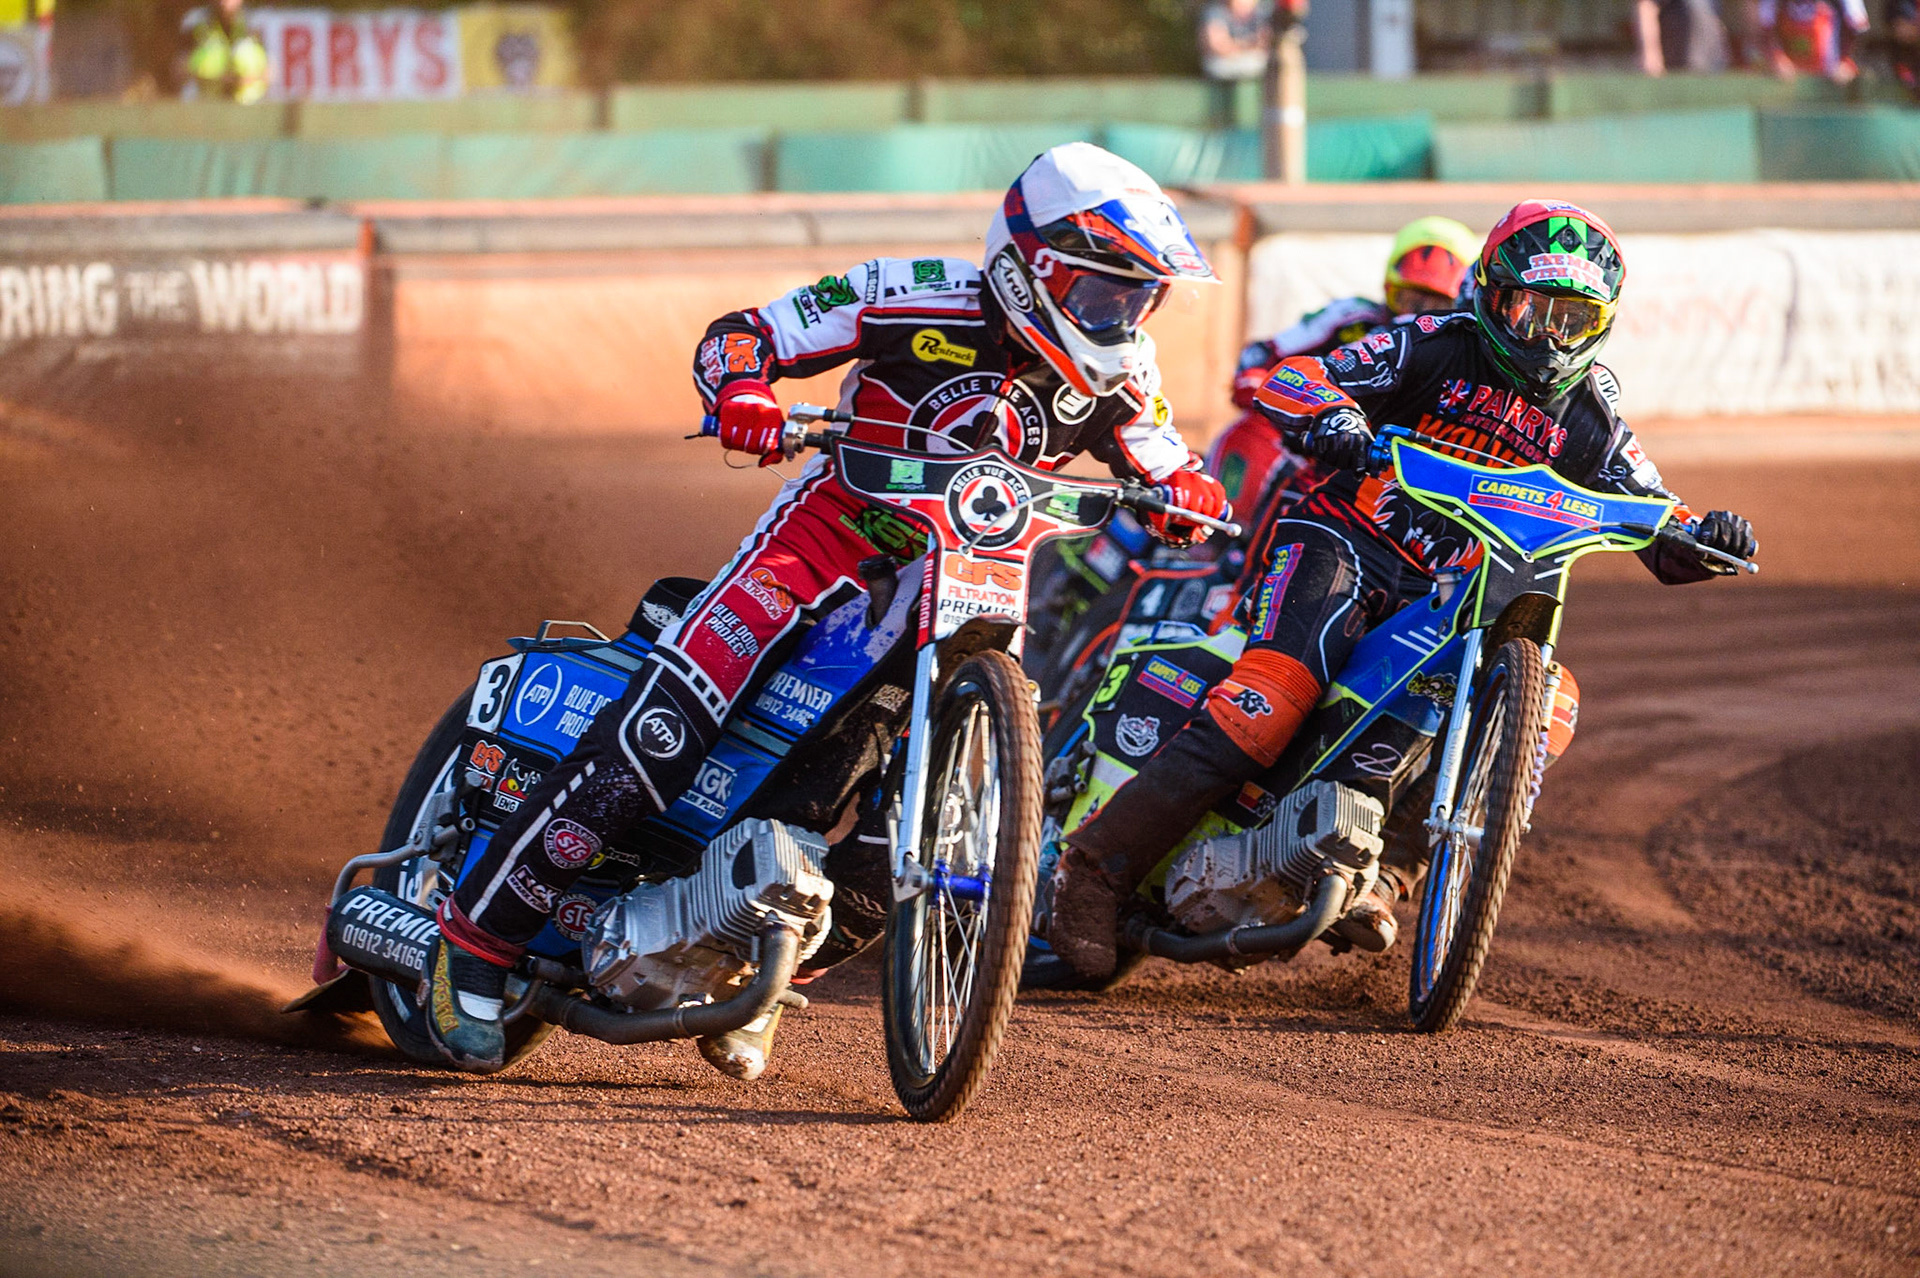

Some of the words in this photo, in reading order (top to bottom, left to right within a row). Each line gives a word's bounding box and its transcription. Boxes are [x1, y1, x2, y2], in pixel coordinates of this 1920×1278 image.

[280, 21, 449, 95] RRYS
[124, 271, 185, 322] THE
[192, 259, 363, 334] WORLD
[996, 256, 1030, 311] Arai
[919, 335, 974, 362] Rentruck
[928, 379, 981, 411] BELLE
[1019, 405, 1040, 447] ACES
[1467, 384, 1568, 458] PARRYS
[952, 467, 982, 493] BELLE
[983, 466, 1008, 480] VUE
[1477, 480, 1547, 504] CARPETS
[1546, 491, 1564, 511] 4
[1562, 498, 1599, 518] LESS
[948, 586, 1017, 608] FILTRATION
[704, 615, 748, 658] PROJECT
[711, 603, 743, 629] BLUE
[734, 624, 760, 657] DOOR
[478, 664, 511, 723] 3
[524, 684, 554, 707] ATPI
[563, 684, 597, 715] BLUE
[764, 671, 833, 713] PREMIER
[1096, 664, 1130, 703] 3
[645, 716, 678, 751] ATPI
[558, 836, 588, 860] STS
[340, 893, 441, 946] PREMIE
[563, 904, 592, 927] STS
[342, 923, 380, 958] 01912
